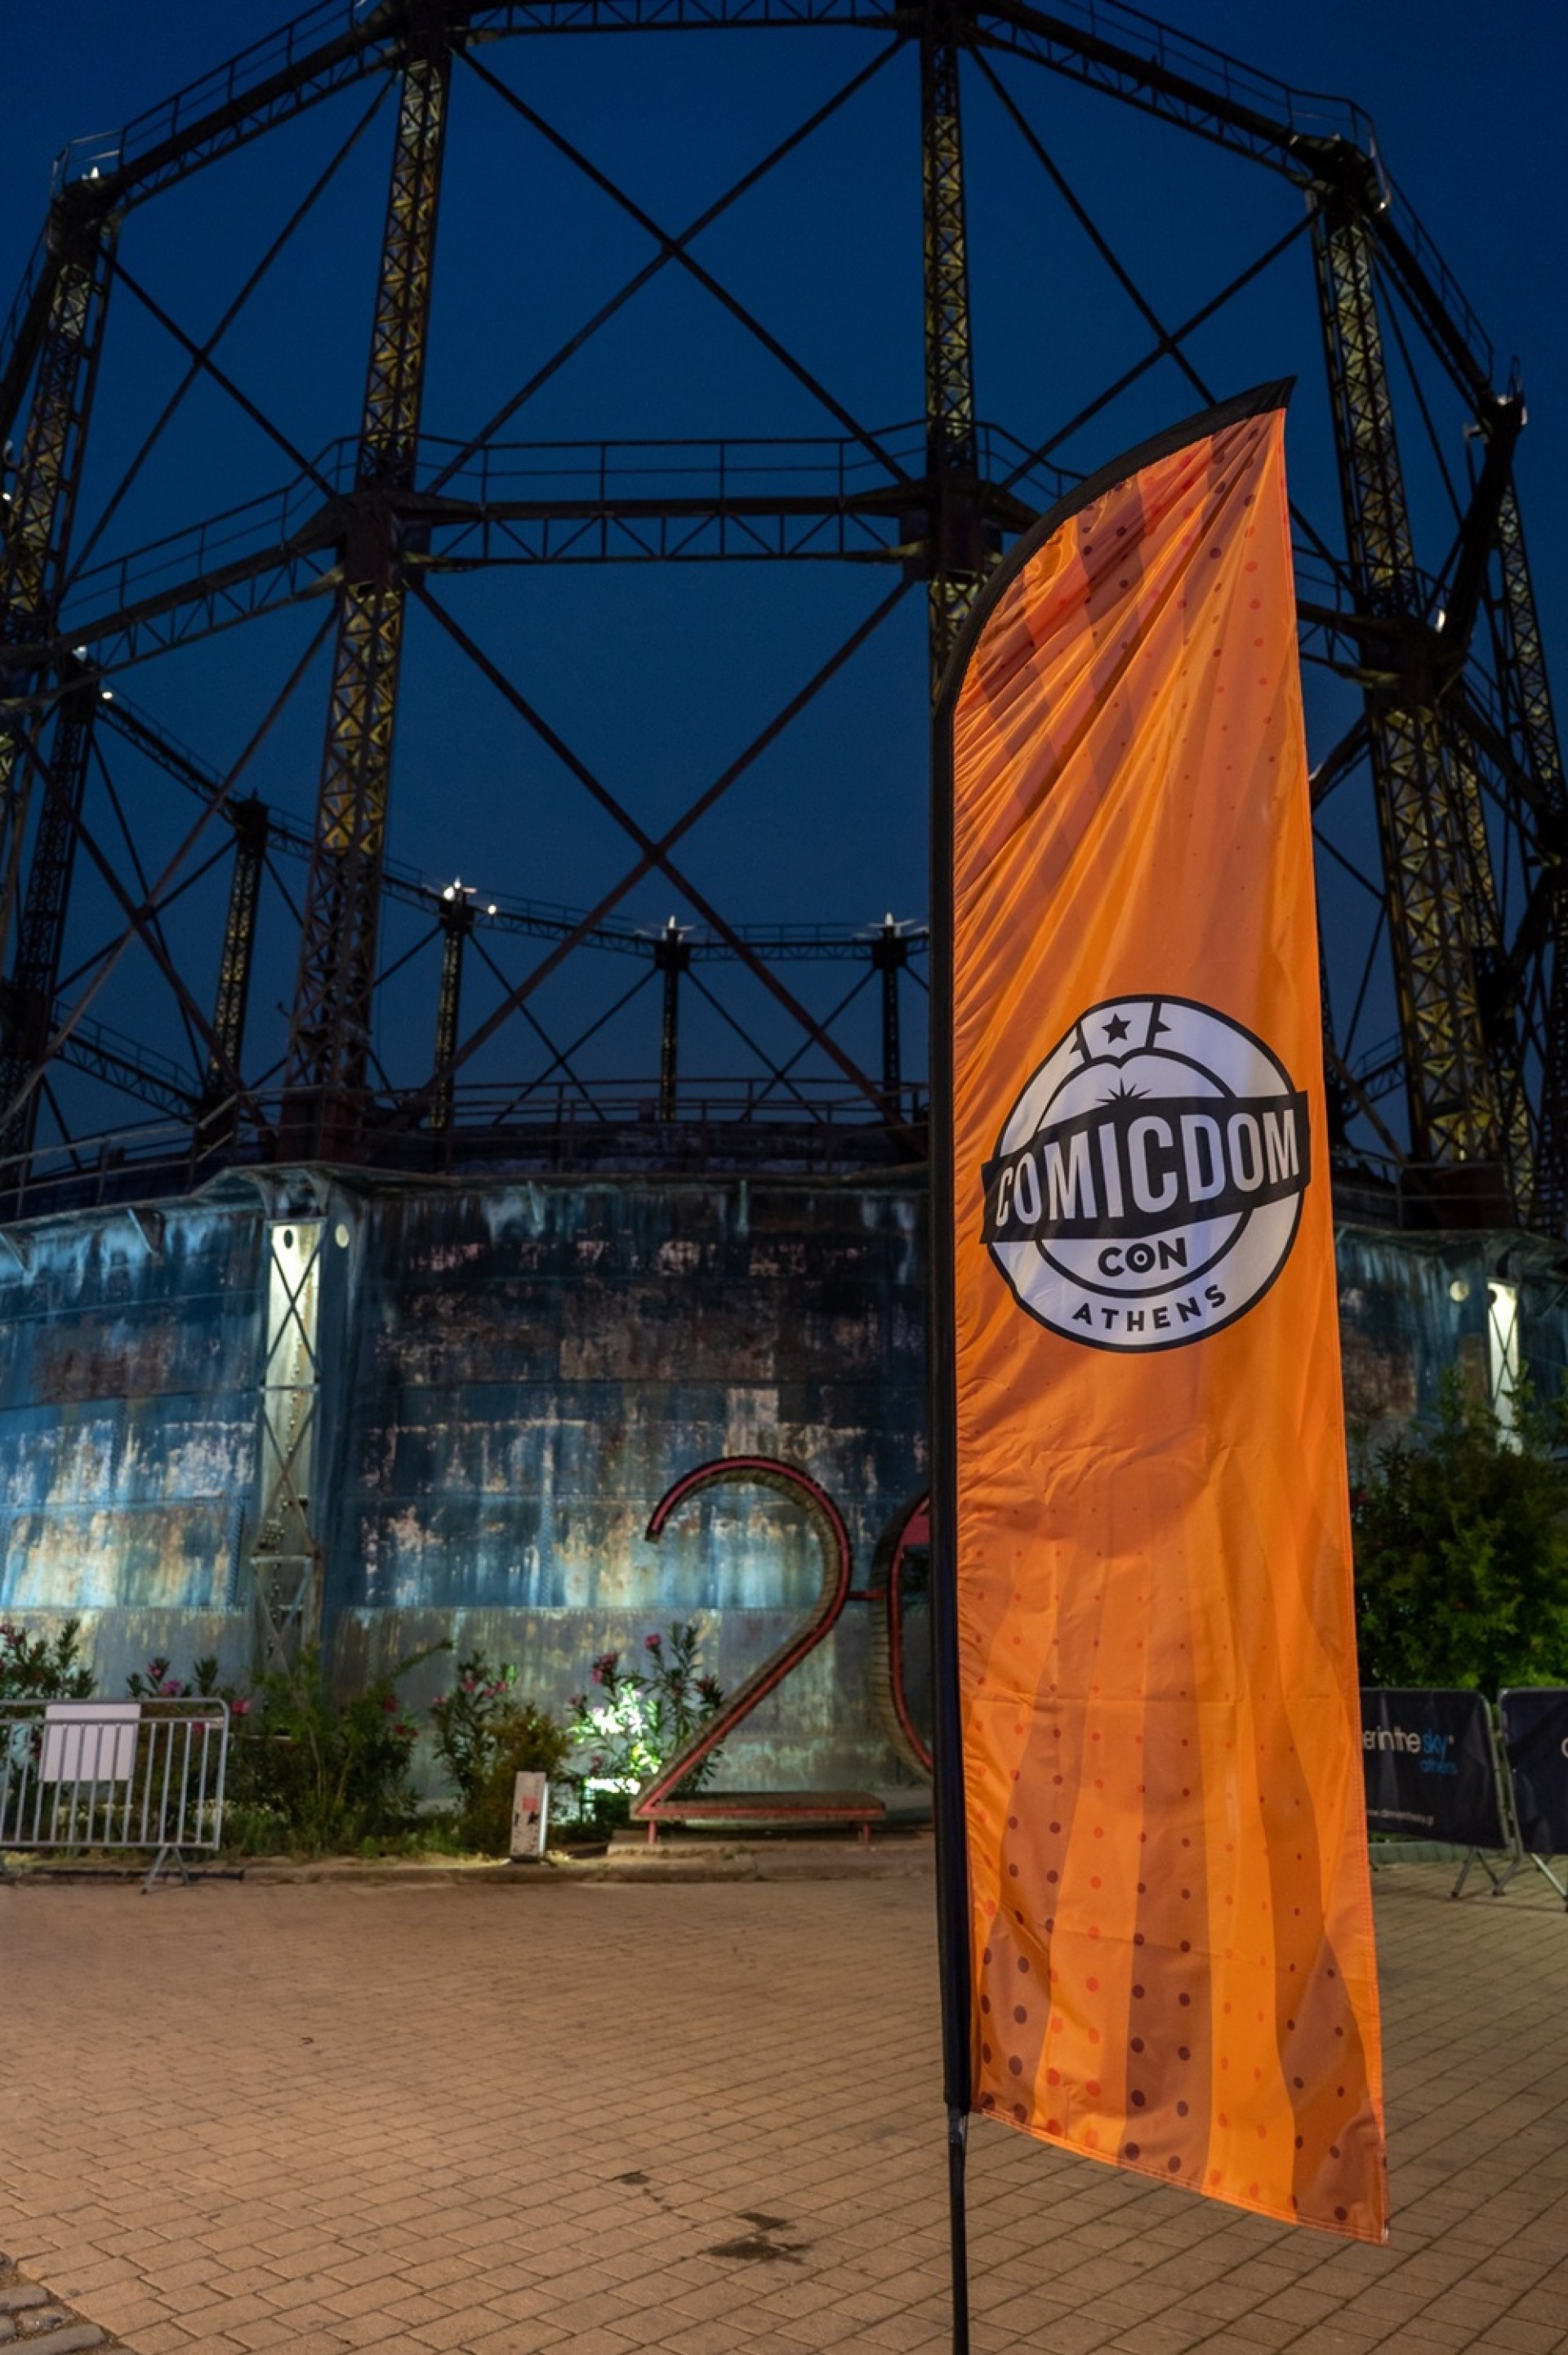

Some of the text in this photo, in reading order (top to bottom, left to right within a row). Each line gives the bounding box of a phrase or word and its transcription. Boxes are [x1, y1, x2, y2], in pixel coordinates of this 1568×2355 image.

[996, 1108, 1300, 1227] COMICDOM
[1098, 1237, 1188, 1277] CON
[1072, 1283, 1227, 1331] ATHENS
